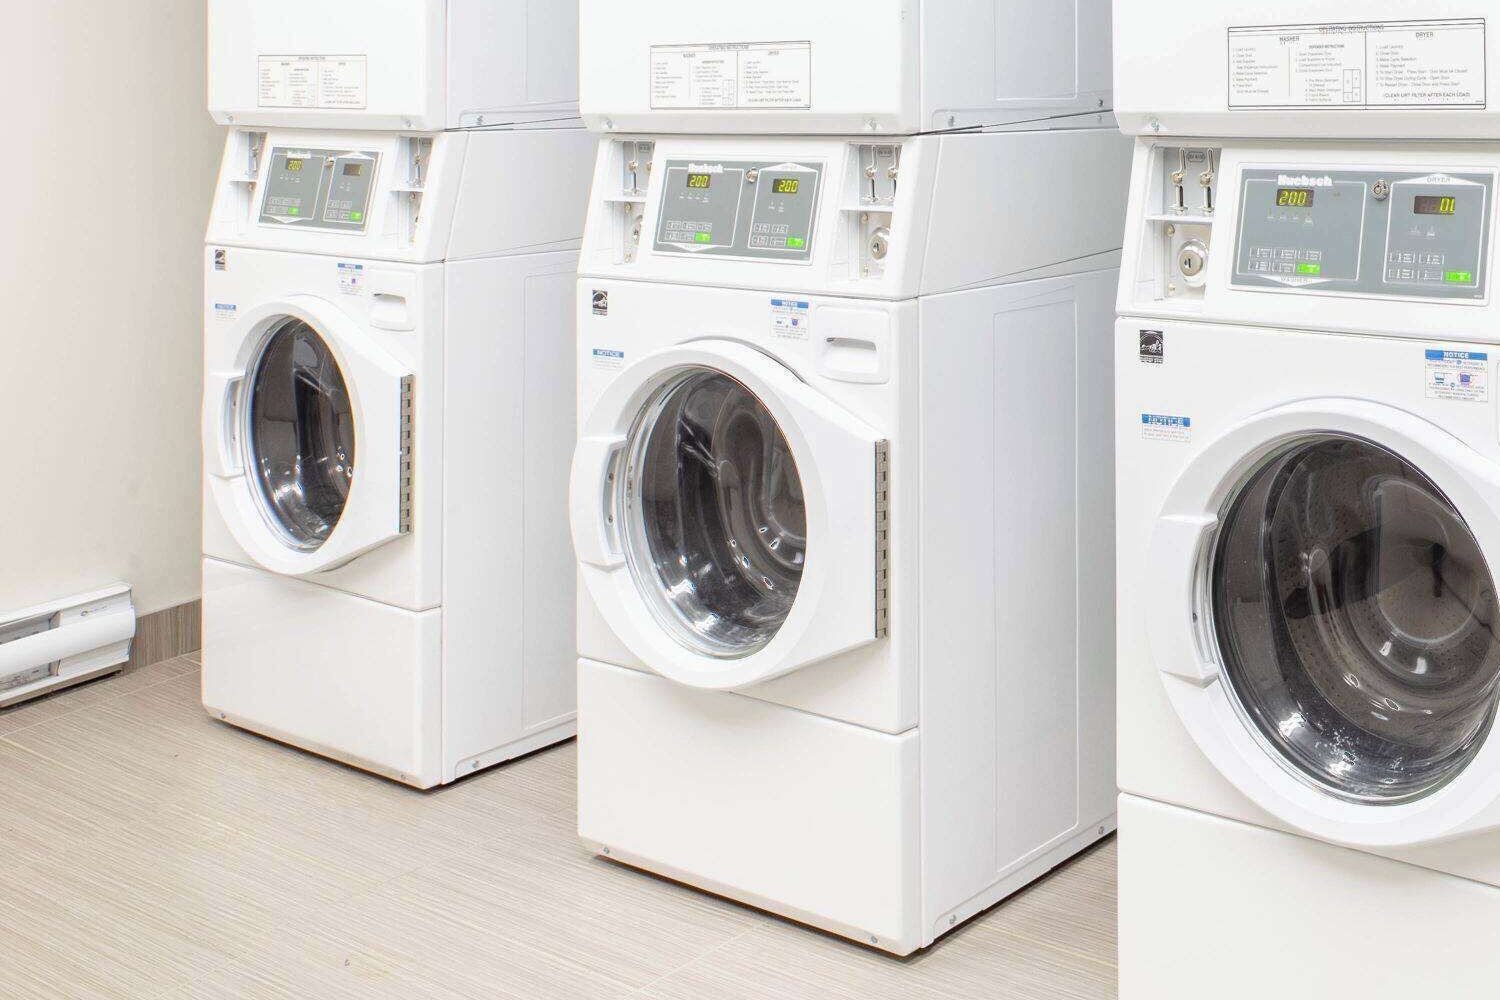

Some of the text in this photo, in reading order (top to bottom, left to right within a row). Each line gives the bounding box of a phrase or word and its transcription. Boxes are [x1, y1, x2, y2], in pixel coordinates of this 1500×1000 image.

[690, 175, 709, 187] 200
[778, 179, 799, 192] 200
[1278, 191, 1307, 206] 200
[1443, 351, 1470, 360] NOTICE
